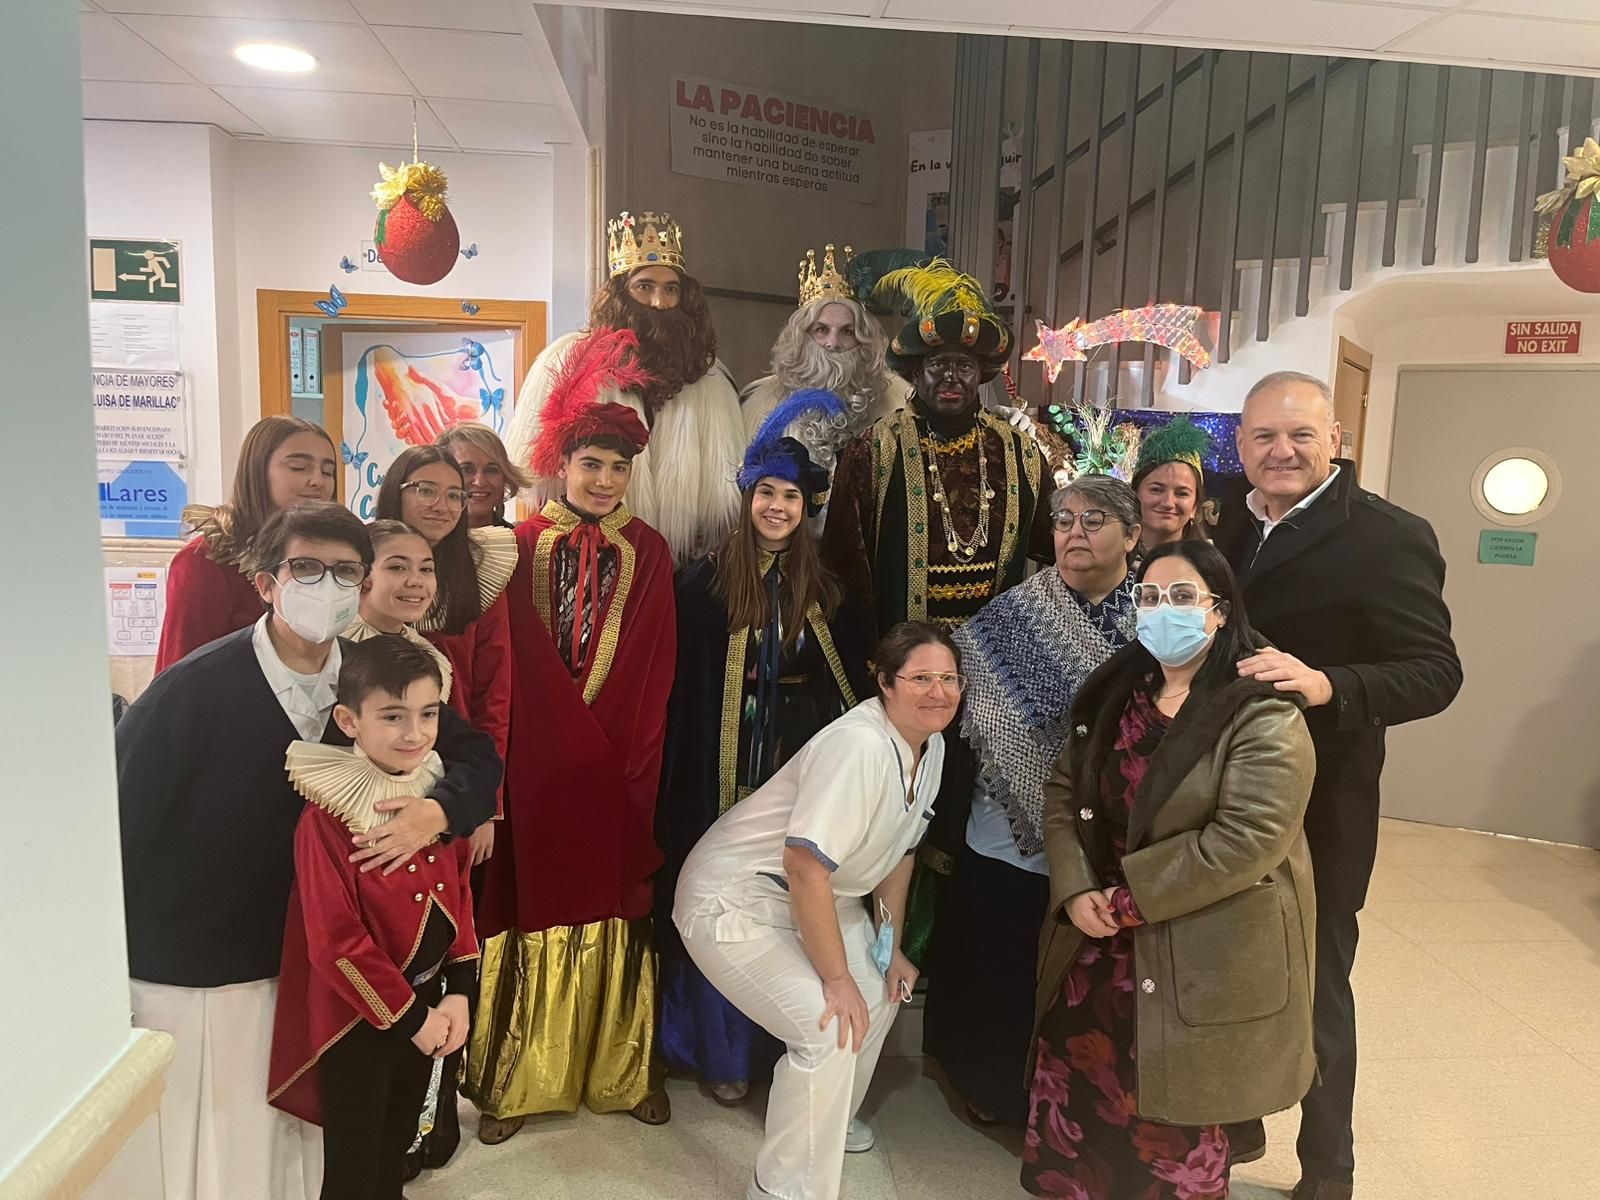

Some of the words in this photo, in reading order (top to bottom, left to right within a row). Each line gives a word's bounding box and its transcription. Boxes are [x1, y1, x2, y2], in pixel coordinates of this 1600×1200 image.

[676, 80, 715, 112] LA
[720, 88, 876, 144] PACIENCIA
[689, 114, 706, 128] No
[709, 119, 724, 131] es
[727, 121, 739, 134] la
[741, 124, 799, 144] habilidad
[801, 136, 816, 148] de
[702, 132, 727, 146] sino
[730, 137, 742, 149] la
[745, 140, 802, 159] habilidad
[804, 151, 818, 162] de
[821, 154, 852, 169] saber
[692, 146, 753, 165] mantener
[756, 158, 779, 169] una
[782, 160, 819, 176] buena
[821, 168, 860, 183] actitud
[910, 160, 926, 173] En
[930, 159, 941, 170] la
[726, 166, 780, 184] mientras
[1510, 323, 1531, 336] SIN
[1534, 322, 1577, 335] SALIDA
[1517, 340, 1538, 353] NO
[1541, 340, 1568, 353] EXIT
[93, 374, 114, 386] NCIA
[116, 375, 128, 387] DE
[130, 375, 175, 388] MAYORES
[94, 394, 117, 407] UISA
[119, 395, 131, 407] DE
[107, 482, 168, 502] Lares
